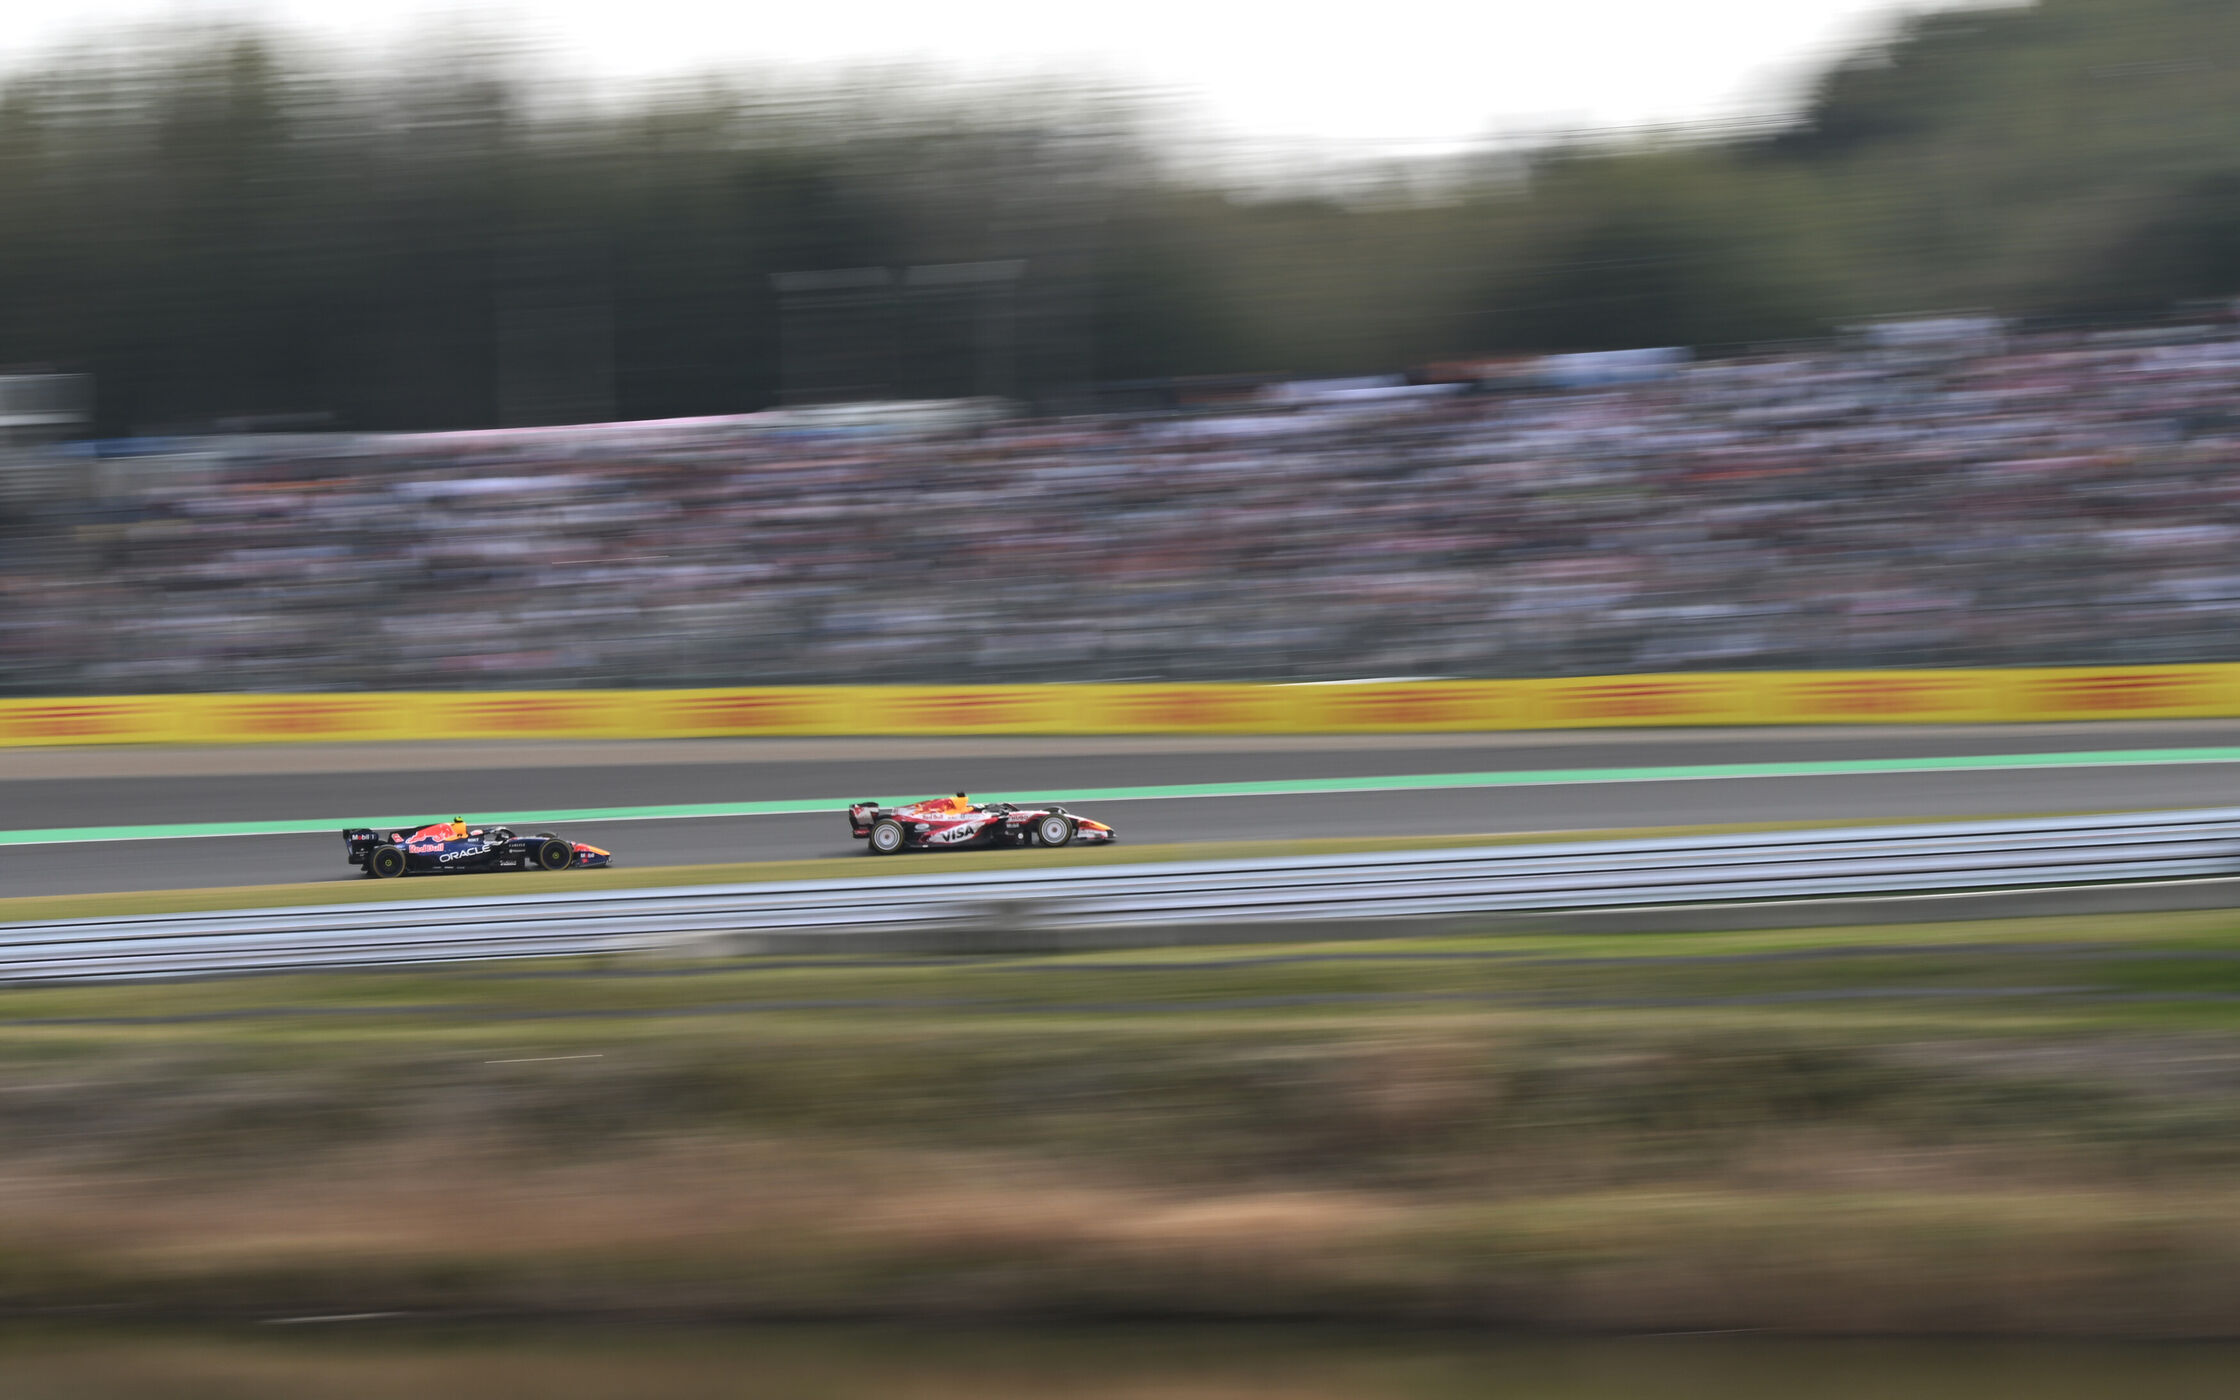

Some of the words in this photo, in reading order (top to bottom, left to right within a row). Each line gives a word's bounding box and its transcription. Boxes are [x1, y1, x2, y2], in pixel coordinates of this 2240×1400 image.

[943, 825, 974, 841] VISA
[409, 844, 426, 854] Red
[427, 843, 444, 852] Bull
[439, 844, 491, 862] ORACLE
